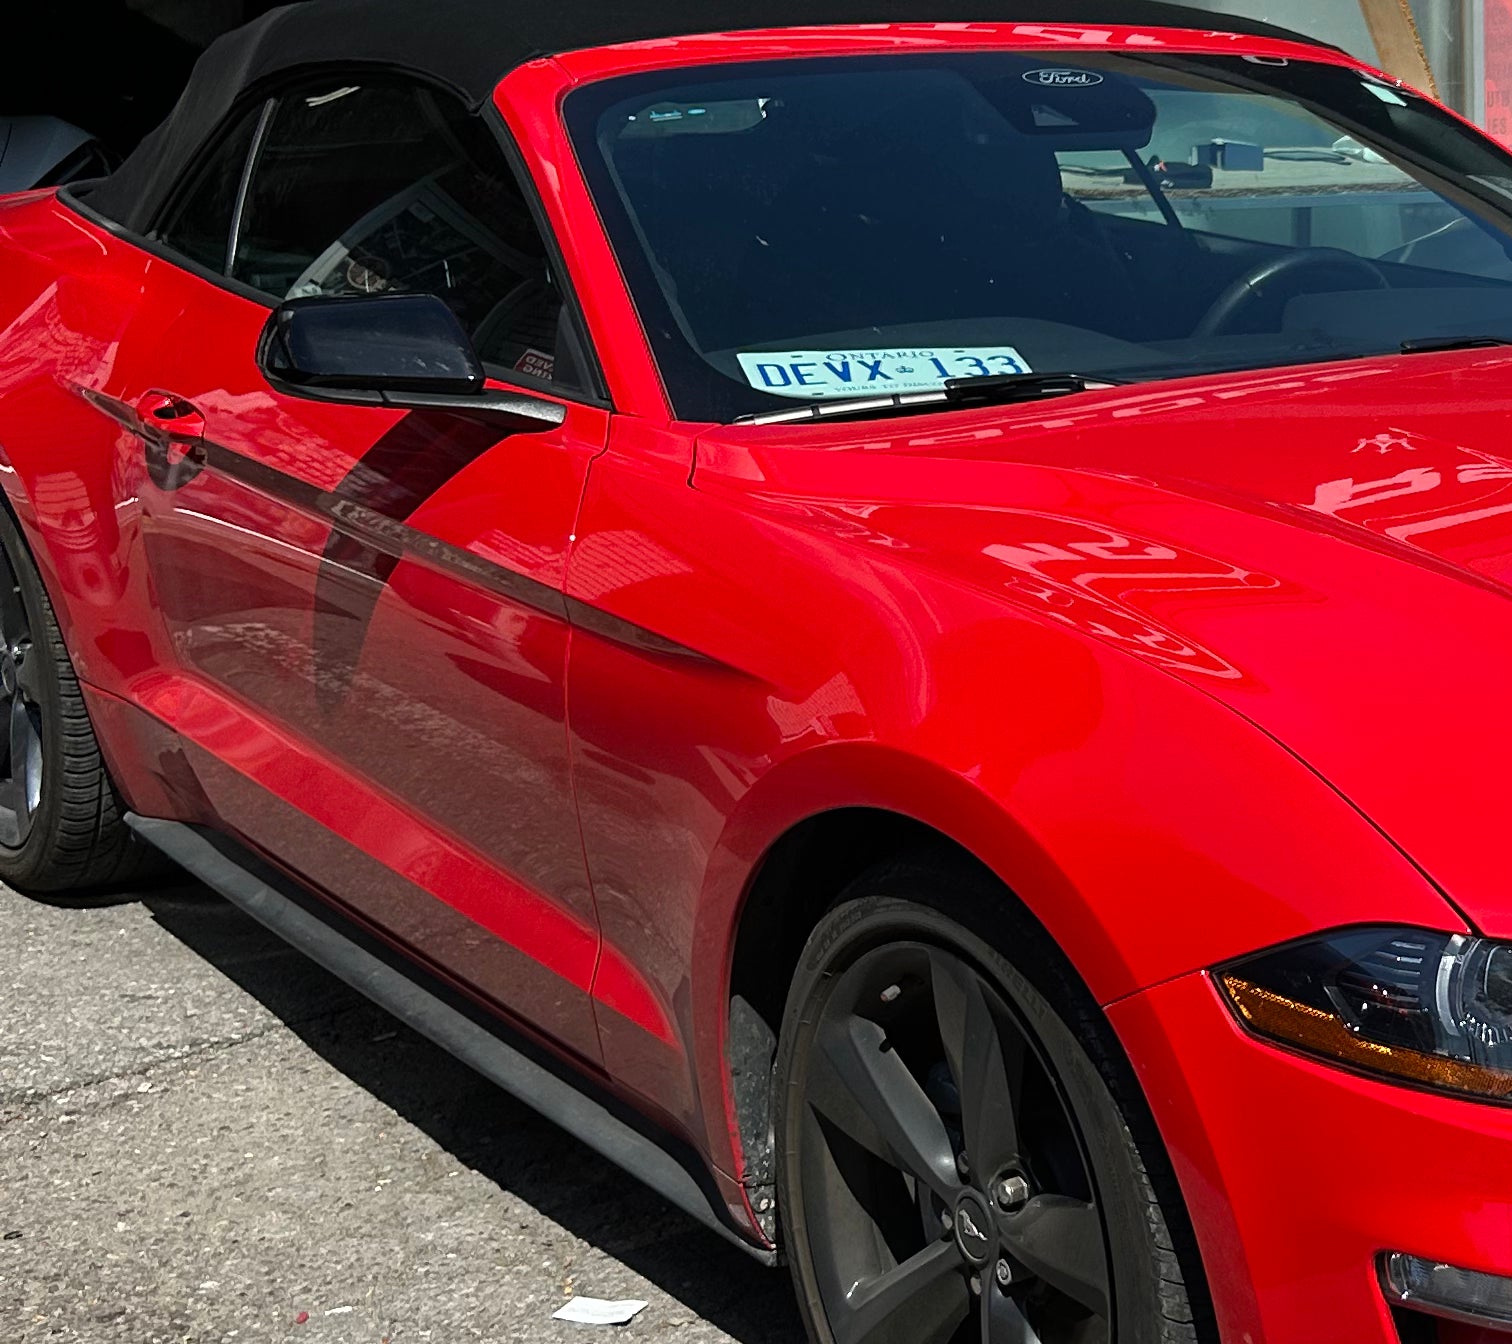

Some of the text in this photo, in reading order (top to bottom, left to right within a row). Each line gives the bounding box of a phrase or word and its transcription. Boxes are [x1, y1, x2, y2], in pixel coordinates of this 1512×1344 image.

[1038, 71, 1091, 85] Ford
[826, 349, 935, 362] ONTARIO
[756, 355, 1025, 387] DEVX 133
